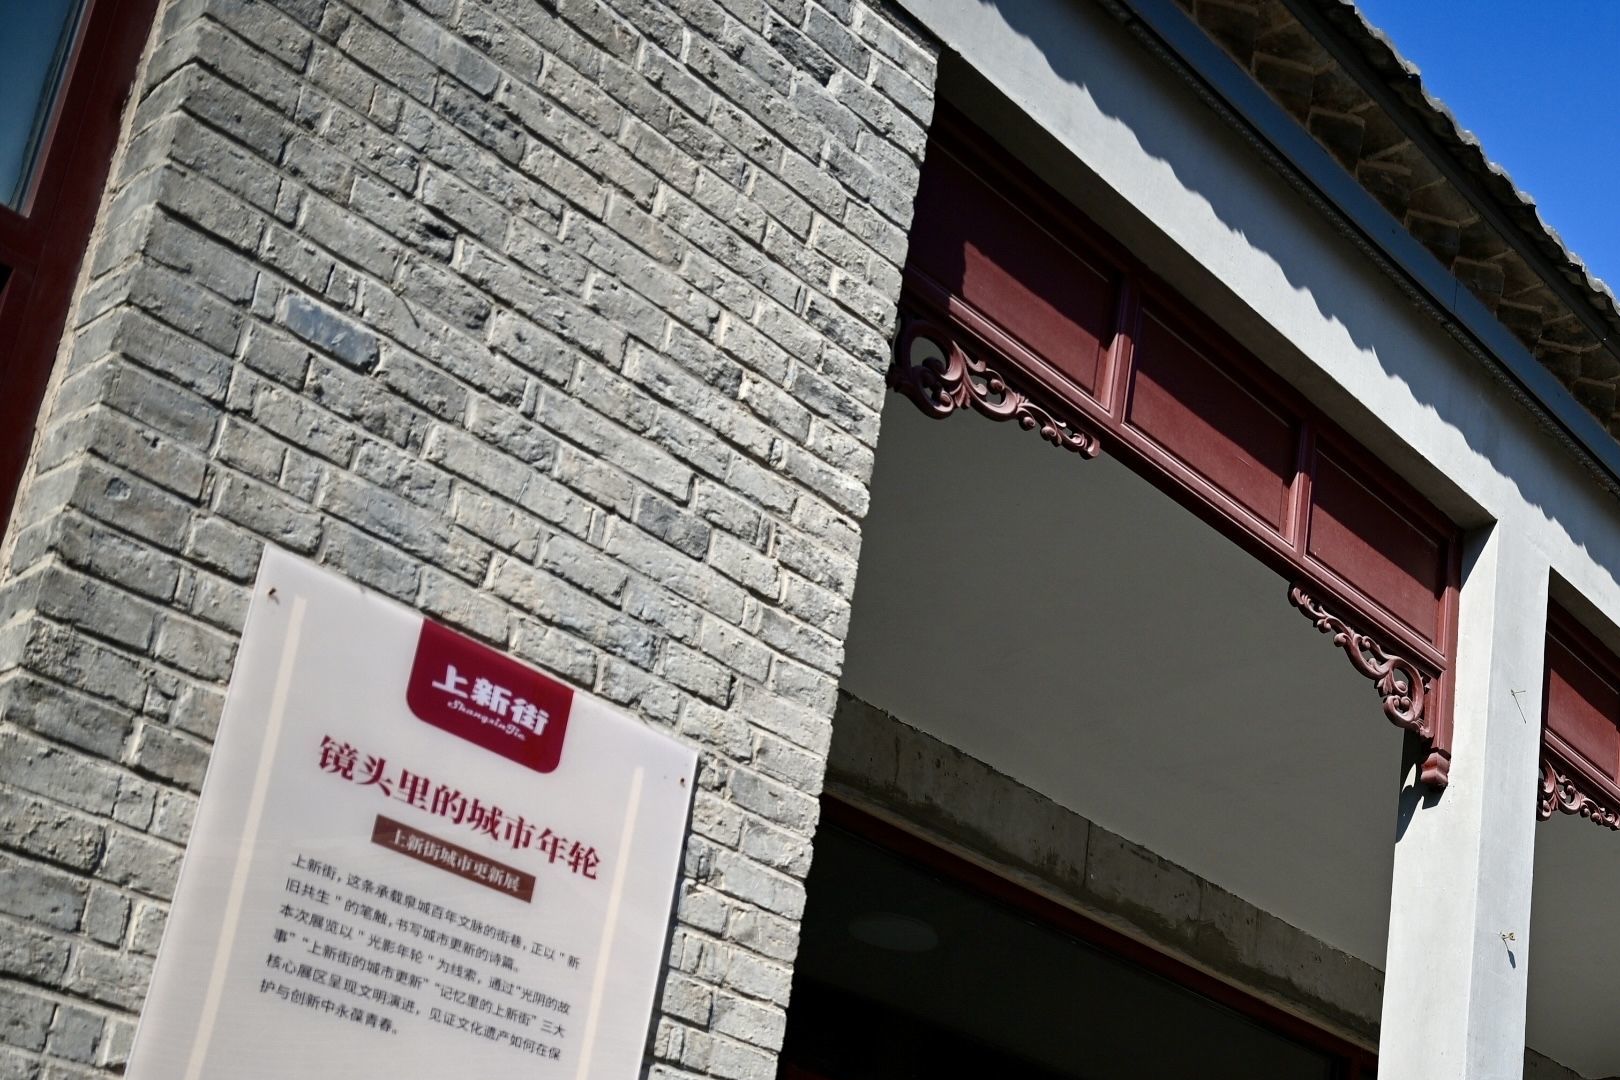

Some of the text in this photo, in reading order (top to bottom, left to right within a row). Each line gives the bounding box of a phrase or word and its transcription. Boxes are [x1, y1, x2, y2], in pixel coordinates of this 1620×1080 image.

[432, 664, 549, 736] 上新街
[319, 735, 600, 880] 镜头里的城市年轮
[392, 829, 520, 892] 上新街城市更新展
